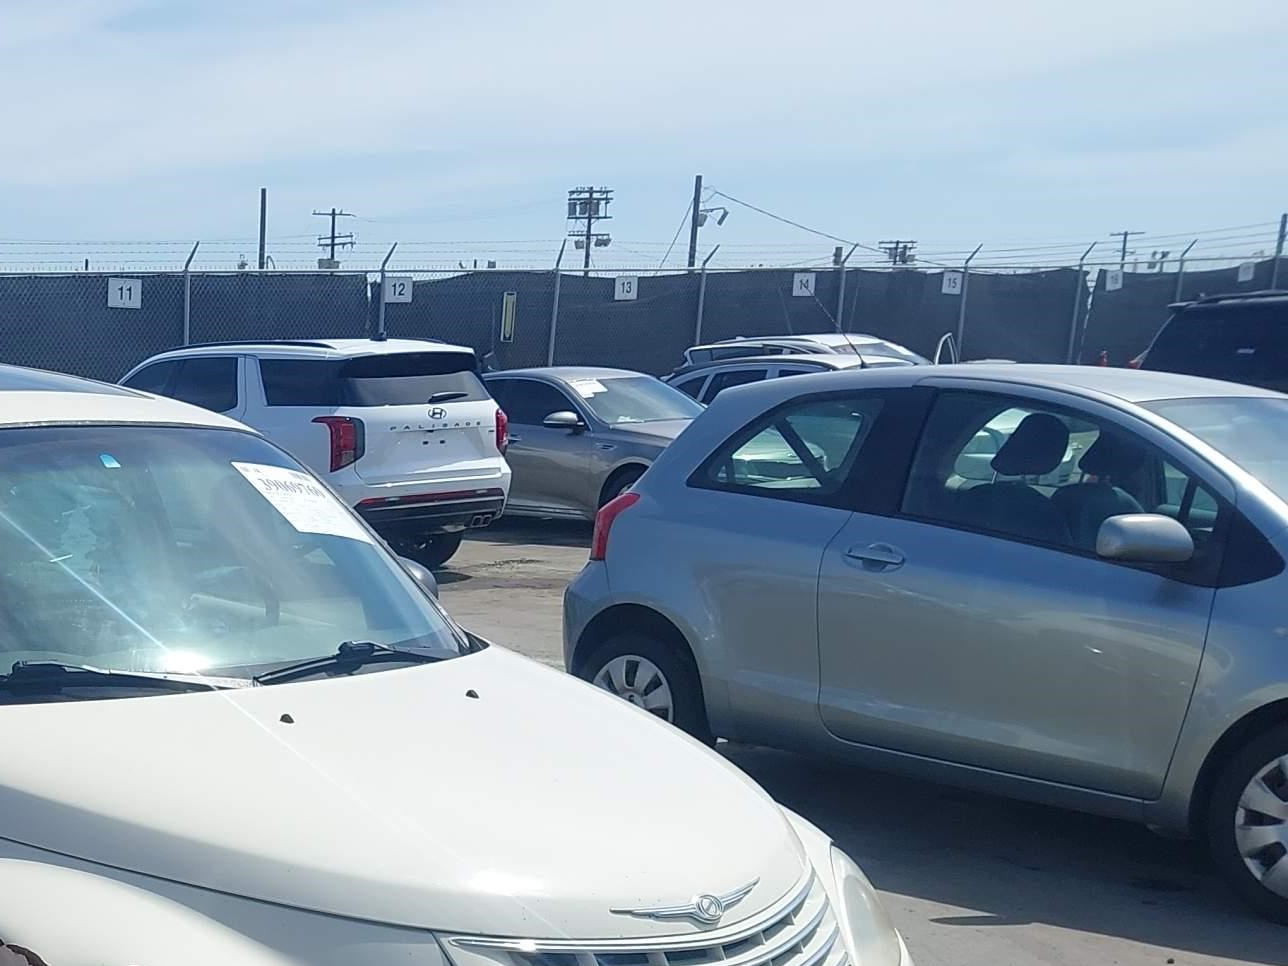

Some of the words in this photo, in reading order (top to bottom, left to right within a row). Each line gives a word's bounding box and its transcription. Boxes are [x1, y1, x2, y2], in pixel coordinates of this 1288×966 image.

[620, 281, 633, 294] 13
[799, 279, 809, 290] 14
[947, 277, 958, 289] 15
[117, 286, 133, 302] 11
[391, 283, 406, 297] 12
[389, 421, 481, 431] PALISADE
